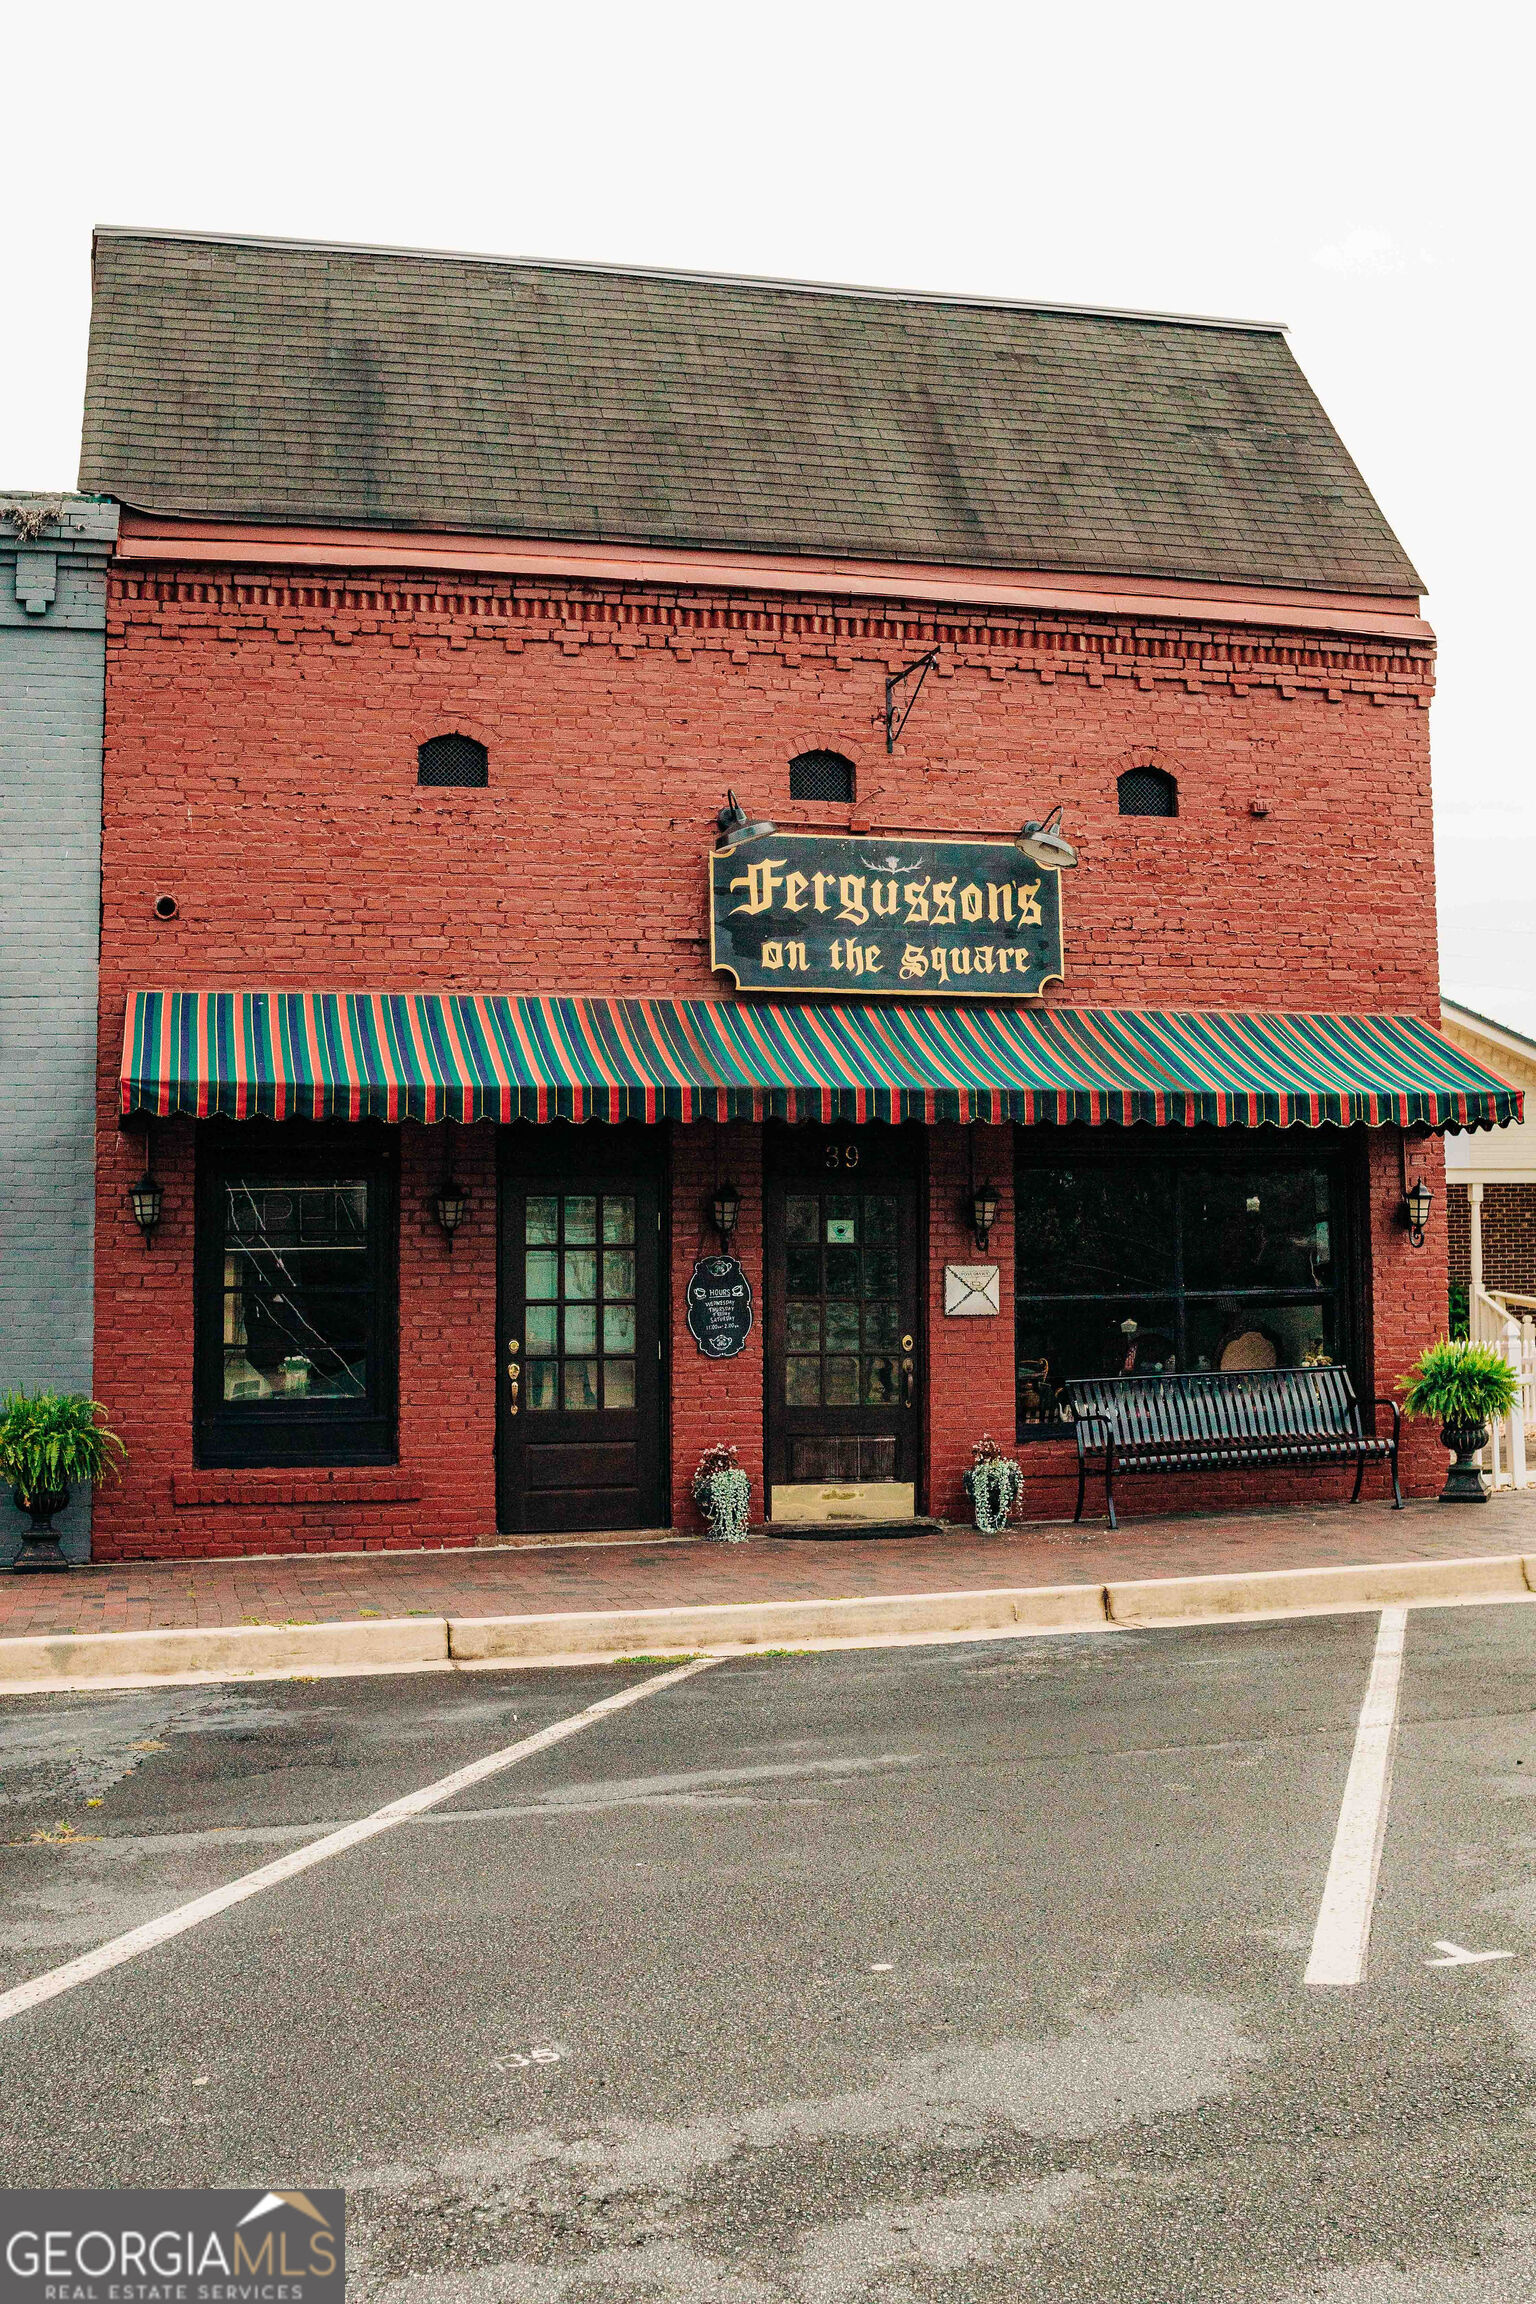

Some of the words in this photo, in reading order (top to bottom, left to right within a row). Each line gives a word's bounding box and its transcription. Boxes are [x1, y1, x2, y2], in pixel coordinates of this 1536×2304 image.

[728, 858, 1043, 928] Fergusson's
[761, 938, 811, 972] on
[829, 937, 884, 976] the
[825, 1144, 859, 1168] 39
